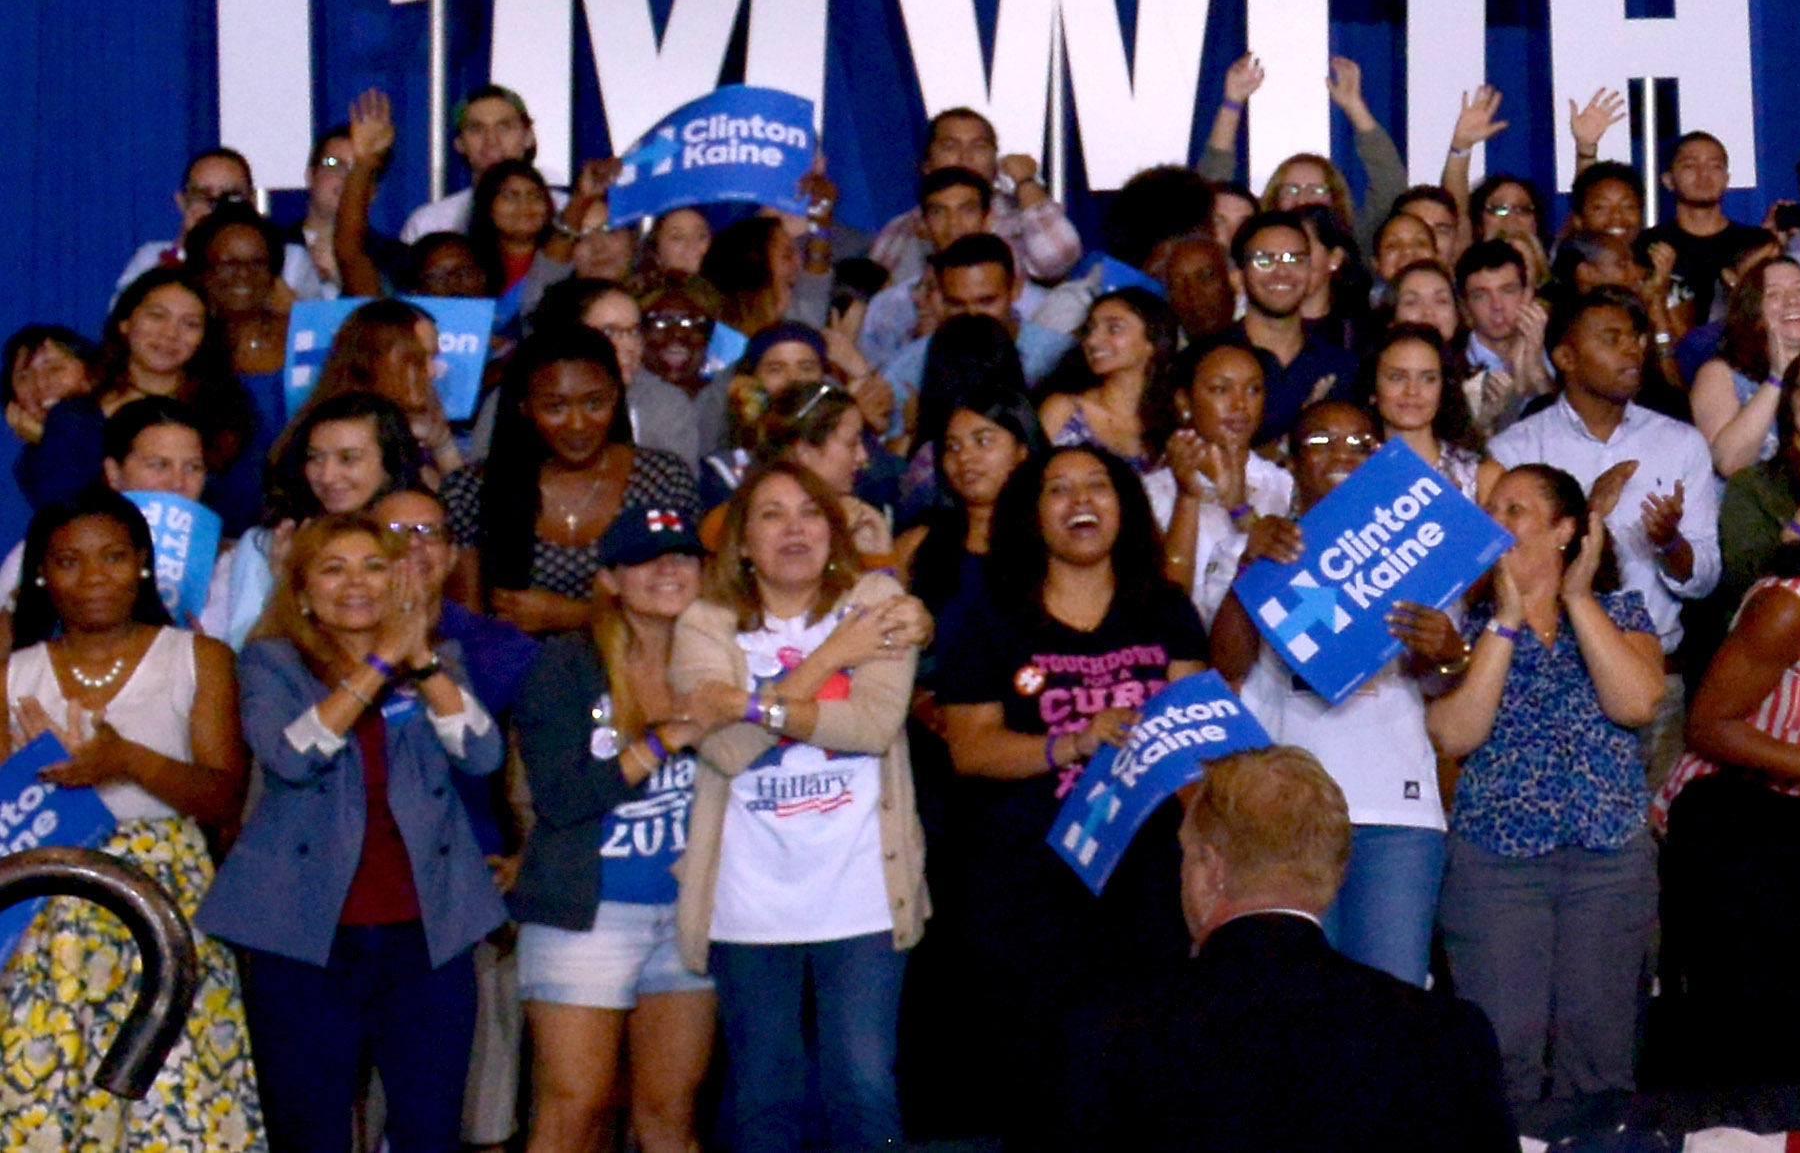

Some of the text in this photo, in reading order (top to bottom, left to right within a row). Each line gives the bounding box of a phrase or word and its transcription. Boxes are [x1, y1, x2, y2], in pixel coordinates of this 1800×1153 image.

[682, 112, 807, 149] Clinton
[682, 139, 784, 168] Kaine
[1319, 476, 1443, 580] Clinton
[1342, 521, 1446, 610] Kaine
[1120, 724, 1228, 789] Kaine
[757, 774, 853, 799] Hillary
